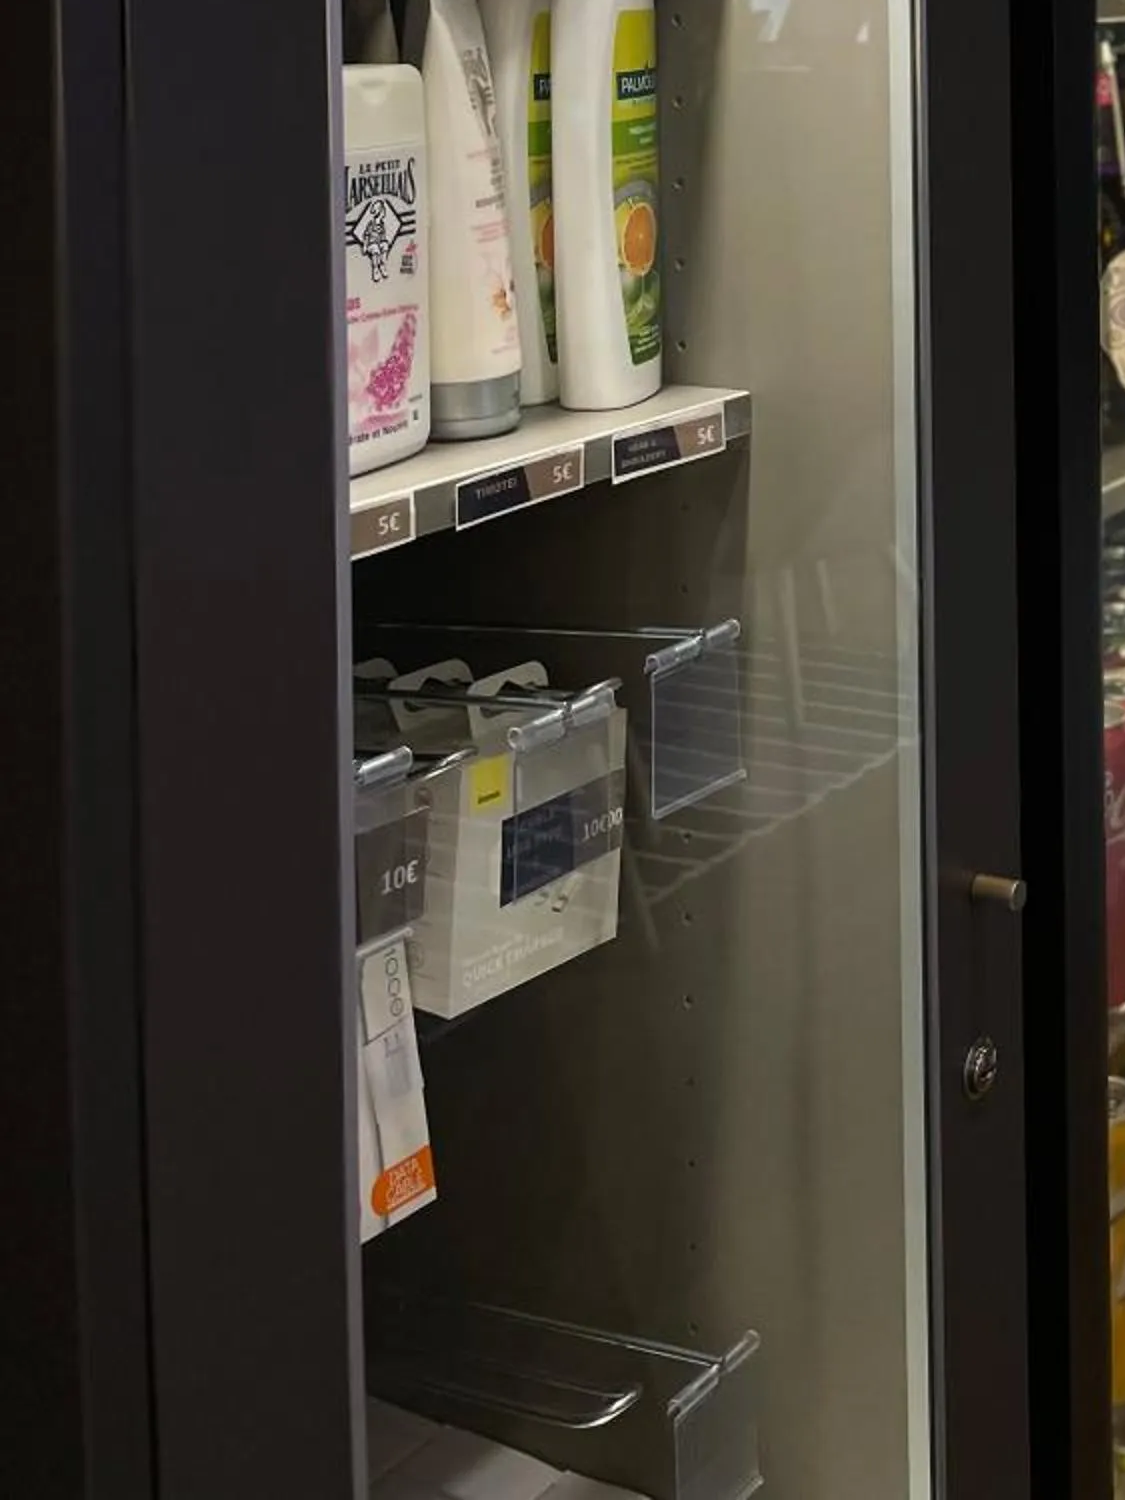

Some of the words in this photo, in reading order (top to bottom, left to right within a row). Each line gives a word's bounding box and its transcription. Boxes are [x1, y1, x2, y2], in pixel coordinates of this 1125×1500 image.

[375, 158, 401, 173] PETIT
[696, 424, 716, 446] 5€
[552, 461, 573, 485] 5€
[377, 511, 401, 536] 5€
[380, 859, 420, 895] 10€
